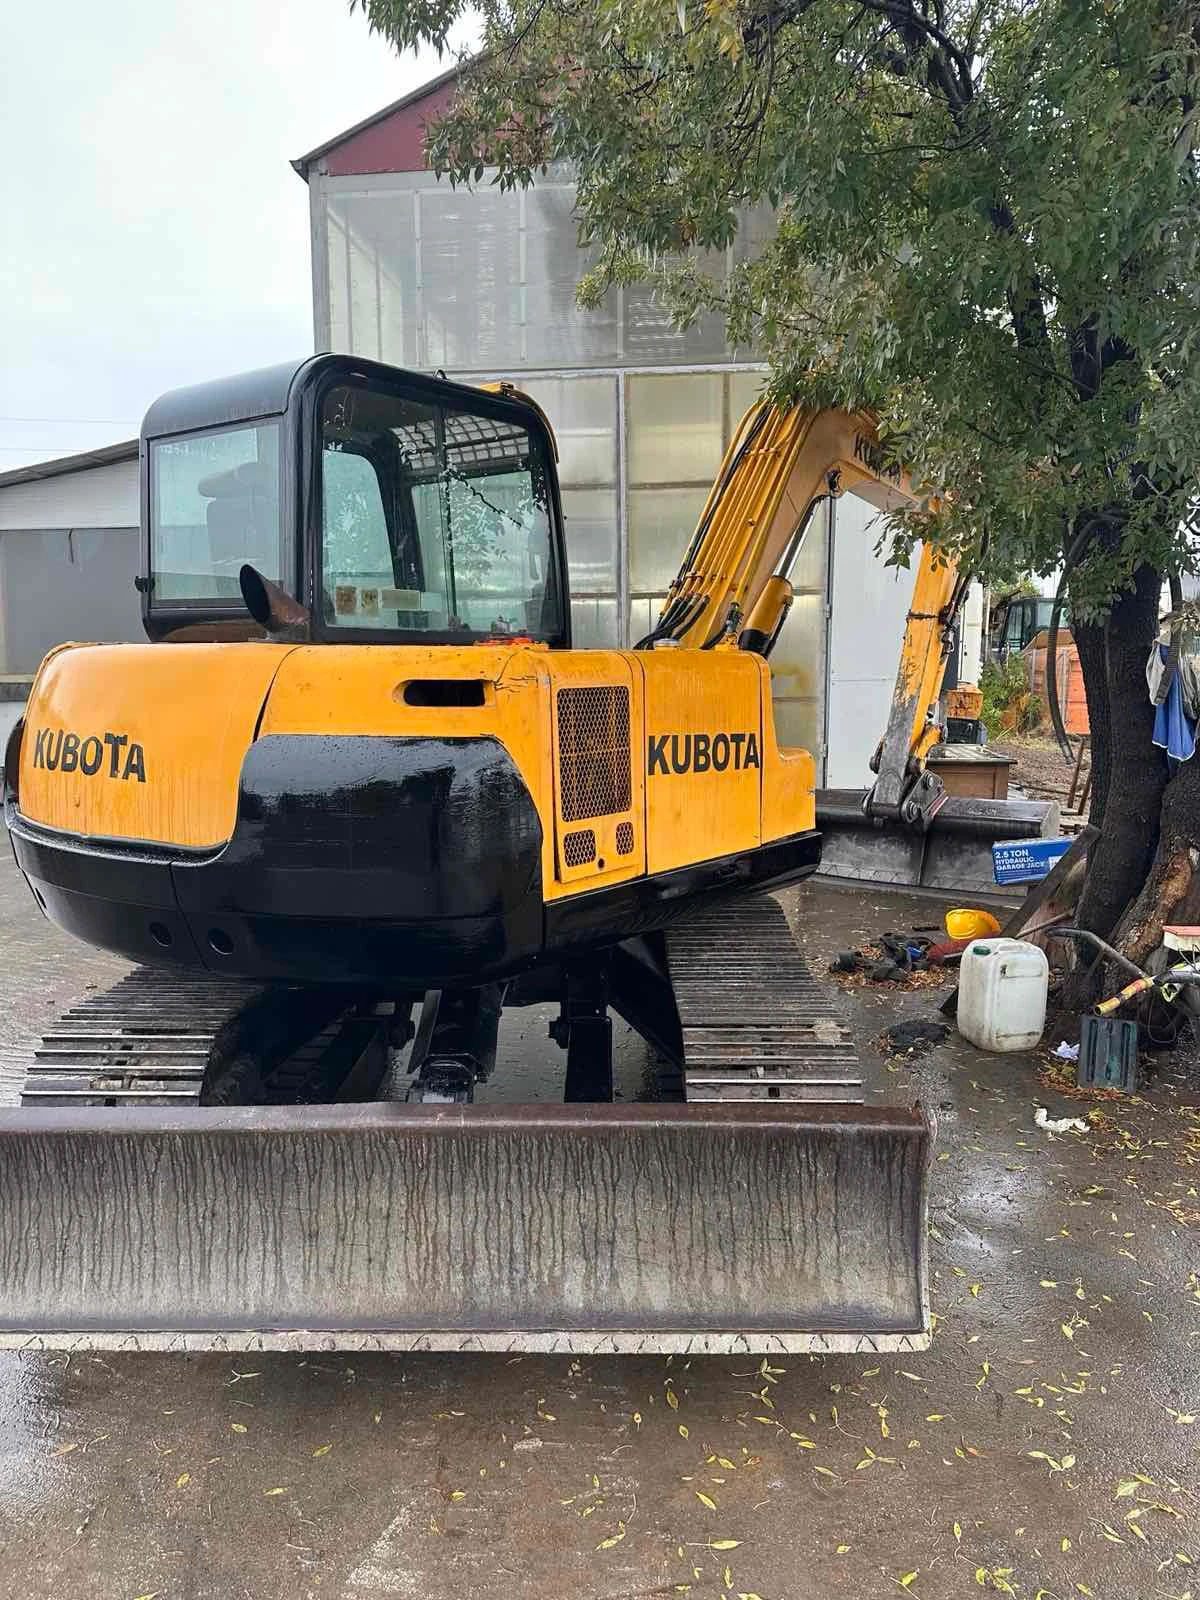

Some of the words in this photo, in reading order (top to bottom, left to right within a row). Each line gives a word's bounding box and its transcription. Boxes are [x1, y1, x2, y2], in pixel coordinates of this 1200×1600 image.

[33, 727, 147, 783] KUBOTA
[647, 733, 760, 776] KUBOTA
[995, 856, 1035, 865] HYDRAULIC
[1010, 849, 1029, 857] TON
